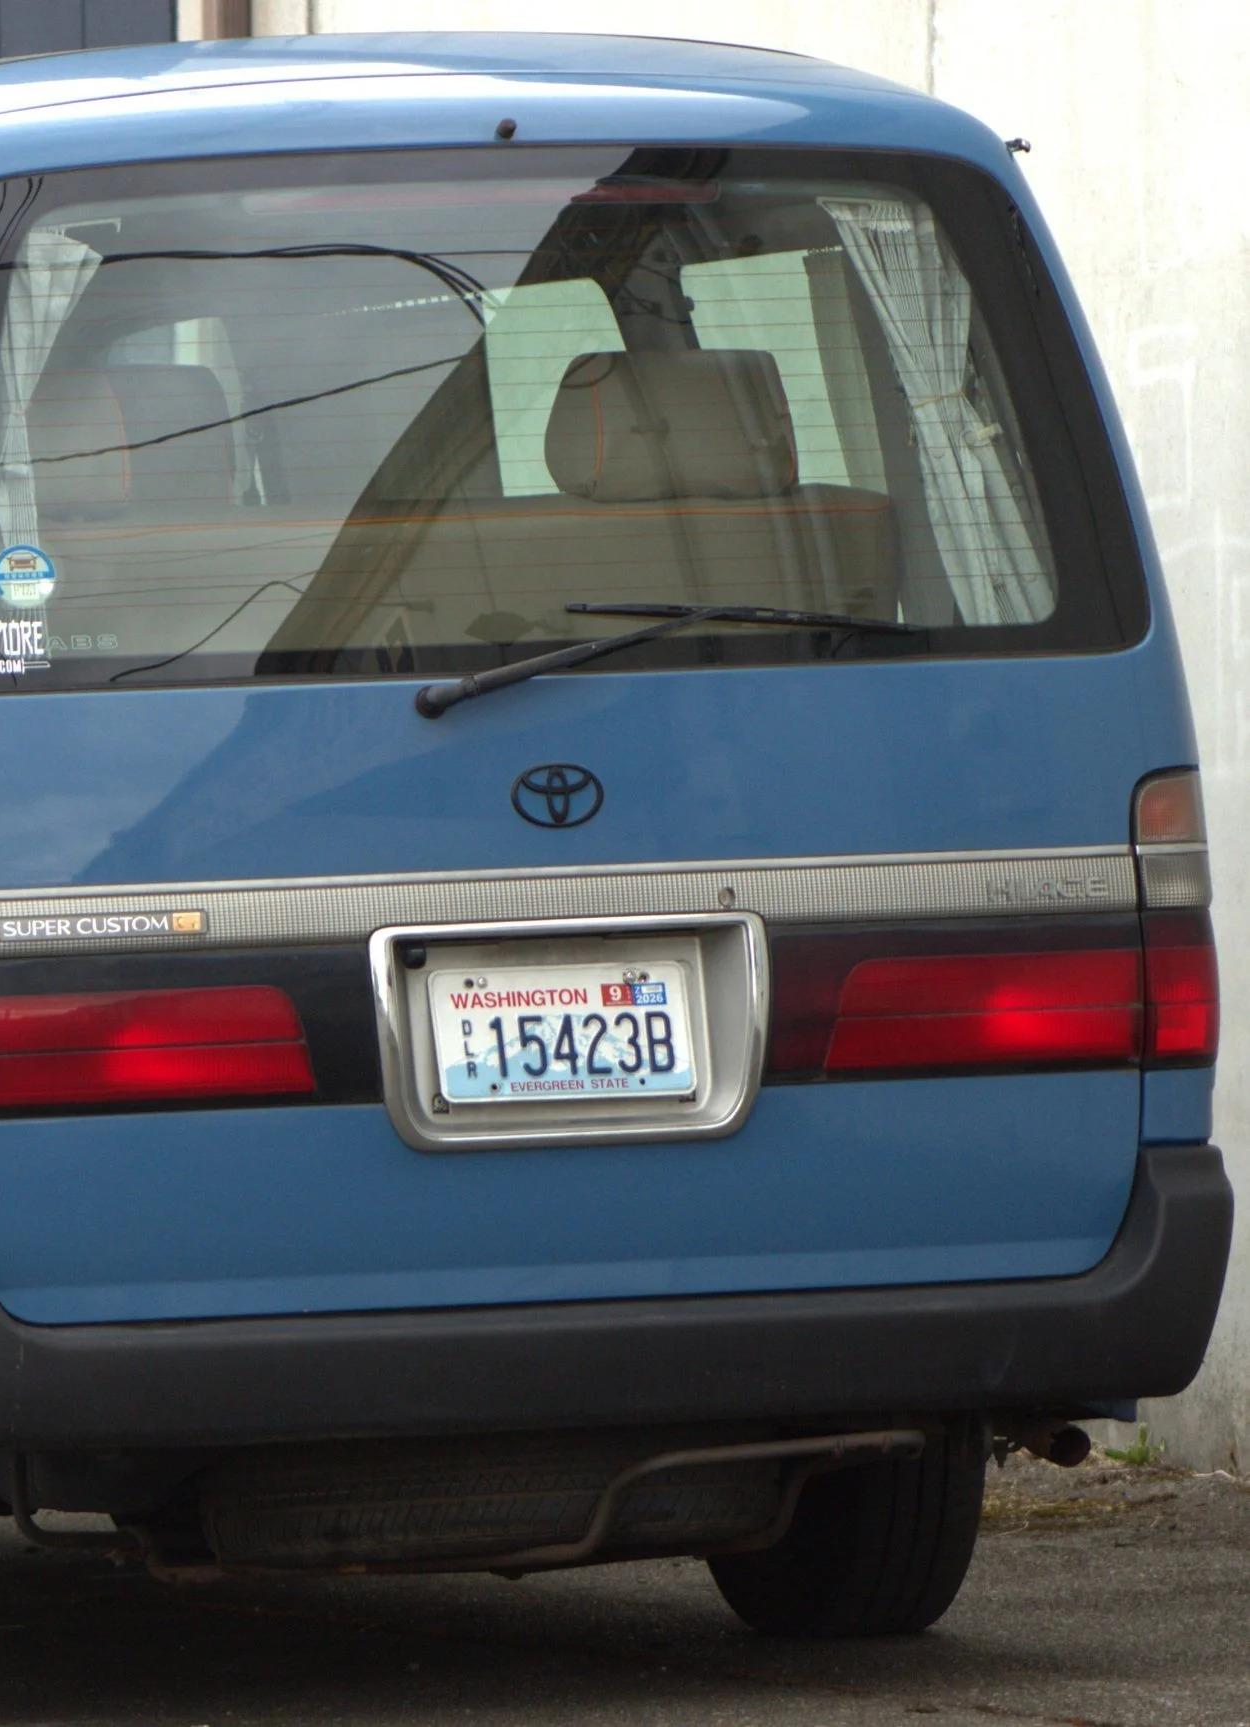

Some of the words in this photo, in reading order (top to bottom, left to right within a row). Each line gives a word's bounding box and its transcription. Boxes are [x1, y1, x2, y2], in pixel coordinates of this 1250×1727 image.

[45, 634, 118, 651] ABS
[987, 876, 1108, 902] HIACE
[2, 918, 71, 937] SUPER
[76, 915, 170, 934] CUSTOM
[450, 988, 588, 1009] WASHINGTON
[609, 985, 622, 1001] 9
[635, 993, 664, 1004] 2026
[461, 1019, 478, 1078] DLR
[490, 1011, 676, 1078] 15423B
[510, 1079, 585, 1092] EVERGREEN
[590, 1077, 629, 1089] STATE
